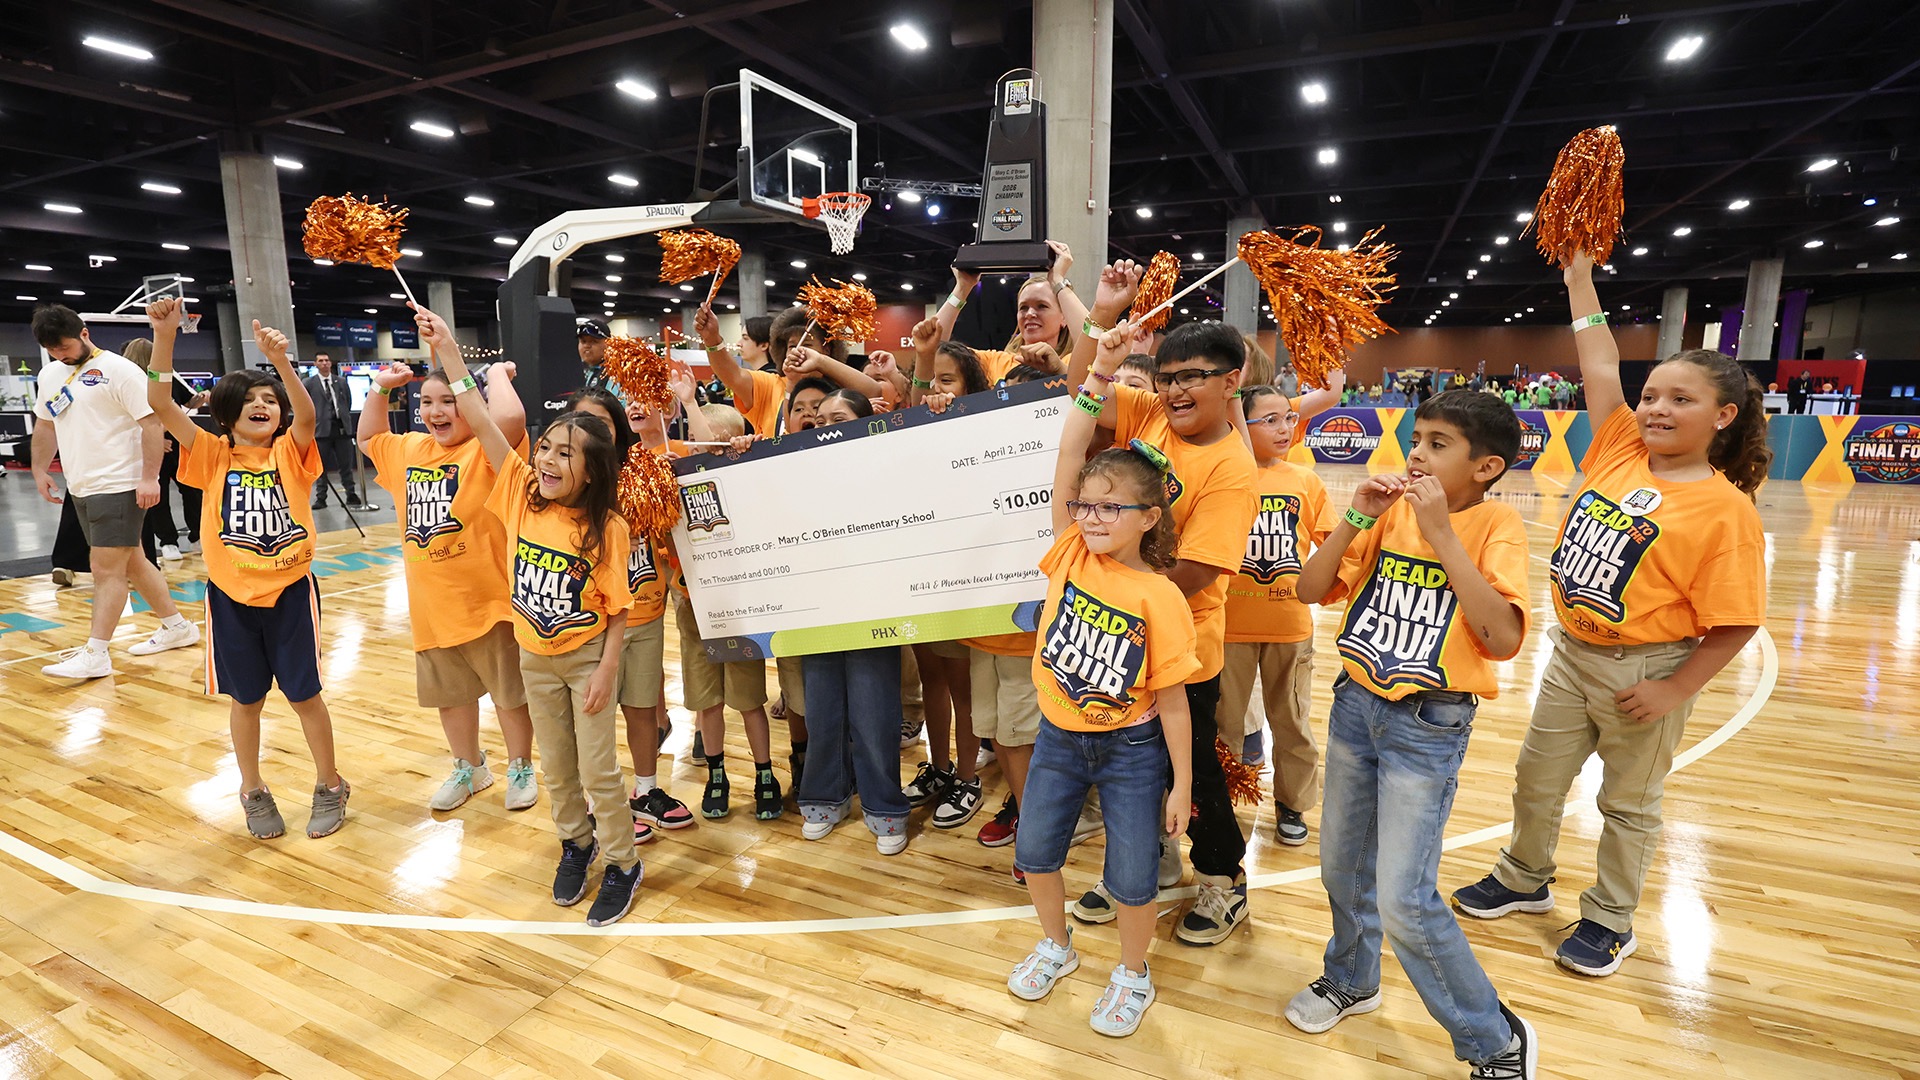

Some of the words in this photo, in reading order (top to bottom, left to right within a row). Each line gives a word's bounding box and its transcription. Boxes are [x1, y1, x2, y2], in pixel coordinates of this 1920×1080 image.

[1010, 86, 1027, 94] FINAL
[995, 192, 1023, 200] CHAMPION
[646, 205, 685, 217] SPALDING
[901, 337, 915, 348] EX
[544, 400, 568, 410] Capi
[1034, 406, 1059, 419] 2026
[1305, 436, 1348, 448] TOURNEY
[1349, 437, 1379, 448] TOWN
[1523, 434, 1542, 448] UR
[951, 457, 979, 470] DATE:
[984, 446, 1006, 460] April
[1007, 445, 1017, 455] 2,
[1019, 440, 1044, 453] 2026
[1849, 443, 1895, 458] FINAL
[1900, 444, 1920, 459] FO
[409, 469, 445, 483] READ
[687, 485, 708, 495] READ
[1169, 479, 1179, 494] TO
[230, 485, 289, 510] FINAL
[685, 490, 717, 509] FINAL
[992, 498, 1001, 510] $
[1262, 498, 1286, 512] AD
[1290, 497, 1299, 507] TO
[689, 504, 720, 520] FOUR
[1286, 503, 1298, 515] THE
[1585, 498, 1634, 531] READ
[229, 509, 292, 537] FOUR
[1253, 510, 1292, 535] NAL
[1638, 521, 1654, 536] TO
[692, 553, 706, 562] PAY
[707, 551, 718, 560] TO
[718, 548, 733, 558] THE
[734, 544, 761, 556] ORDER
[761, 542, 776, 551] OF:
[778, 535, 800, 547] Mary
[801, 532, 811, 542] C.
[812, 528, 846, 540] O'Brien
[847, 517, 900, 534] Elementary
[901, 510, 935, 525] School
[1565, 507, 1631, 567] FINAL
[1626, 526, 1646, 545] THE
[428, 542, 466, 559] Helis
[1245, 535, 1294, 561] OUR
[275, 549, 312, 568] Helis
[518, 542, 568, 573] READ
[629, 543, 650, 571] UR
[1560, 536, 1620, 593] FOUR
[566, 566, 583, 581] THE
[573, 560, 587, 571] TO
[1381, 557, 1447, 588] READ
[699, 577, 712, 586] Ten
[712, 572, 747, 584] Thousand
[748, 567, 762, 578] and
[763, 564, 791, 577] 00/100
[909, 581, 931, 592] NCAA
[940, 576, 971, 588] Phoenix
[972, 573, 994, 584] Local
[995, 568, 1040, 582] Organizing
[1268, 586, 1292, 598] Heli
[1368, 573, 1453, 627] FINAL
[708, 607, 726, 619] Read
[726, 606, 734, 617] to
[735, 604, 748, 615] the
[748, 603, 766, 614] Final
[766, 603, 784, 612] Four
[1073, 594, 1128, 635] READ
[871, 626, 898, 639] PHX
[1135, 622, 1145, 636] TO
[1351, 607, 1441, 661] FOUR
[1059, 603, 1131, 676] FINAL
[1125, 629, 1144, 647] THE
[1047, 629, 1124, 700] FOUR
